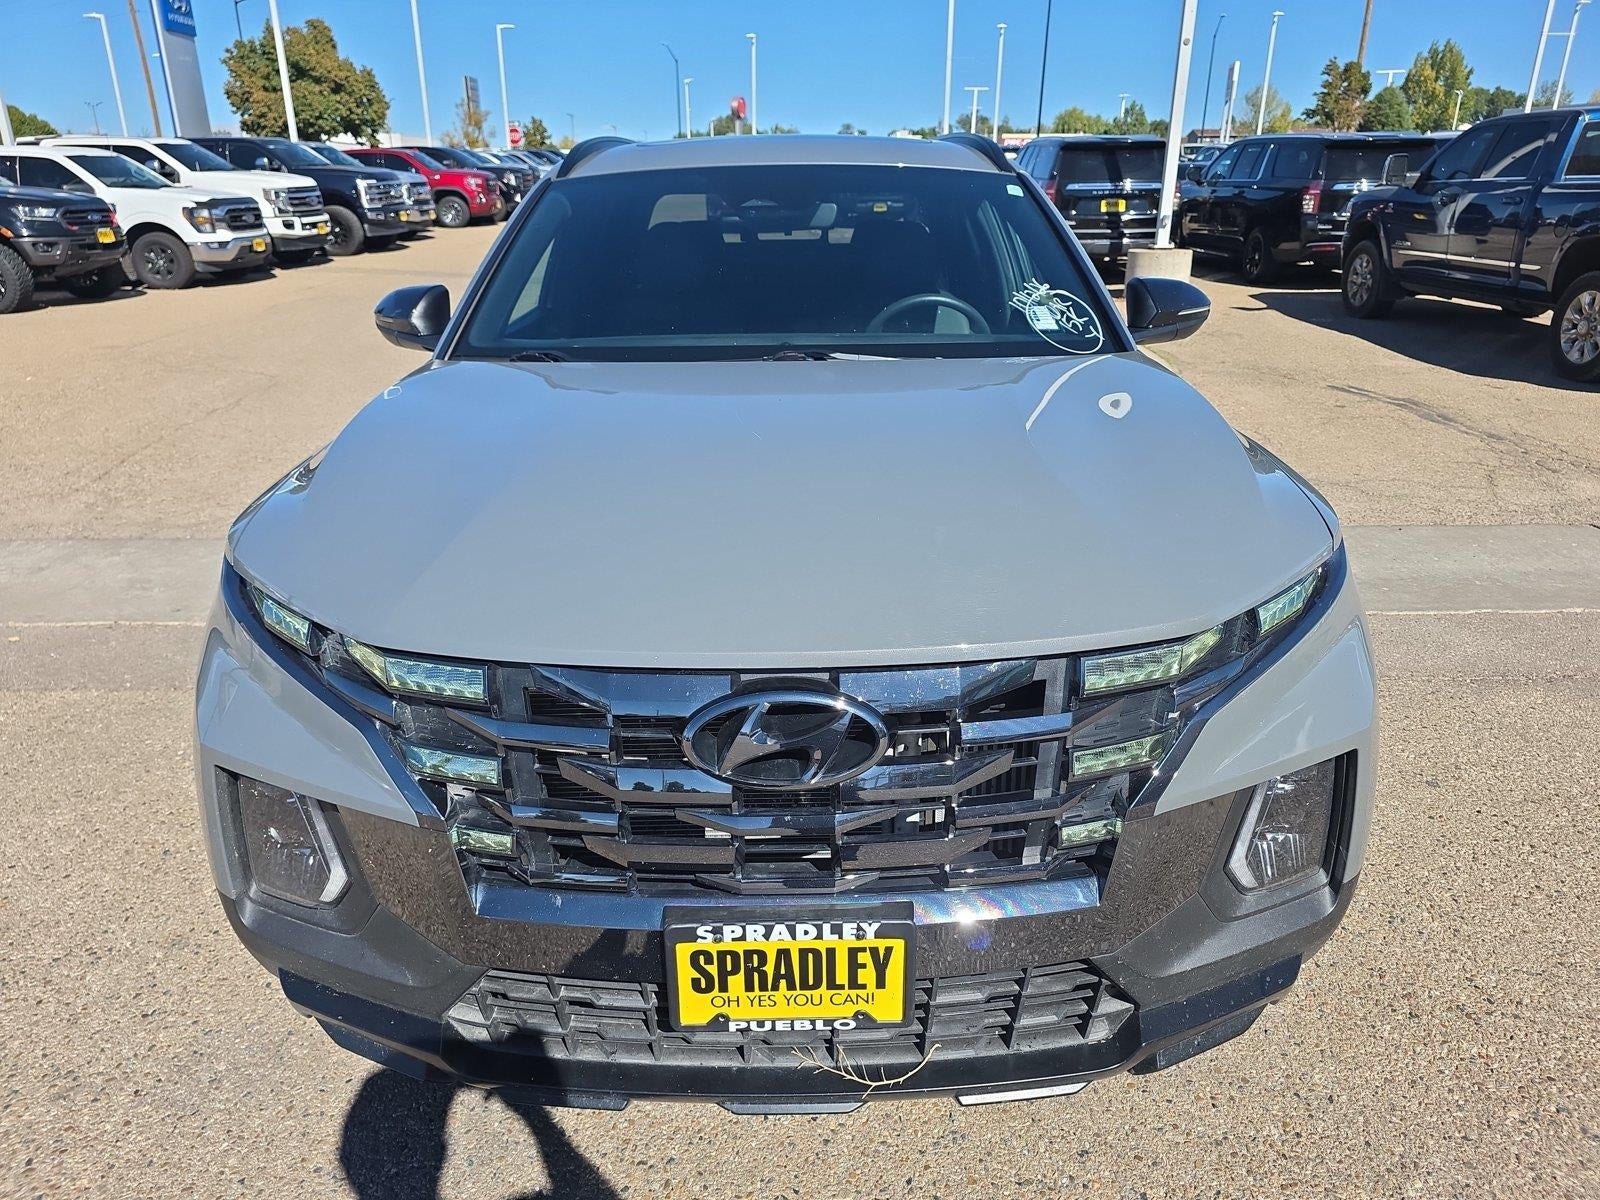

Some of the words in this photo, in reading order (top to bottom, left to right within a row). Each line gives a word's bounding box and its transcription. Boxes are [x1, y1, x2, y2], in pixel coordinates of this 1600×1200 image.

[696, 922, 881, 943] SPRADLEY
[689, 946, 894, 995] SPRADLEY
[711, 995, 740, 1008] OH
[746, 994, 777, 1008] YES
[783, 993, 823, 1007] YOU
[830, 992, 875, 1006] CAN!
[728, 1019, 857, 1032] PUEBLO
